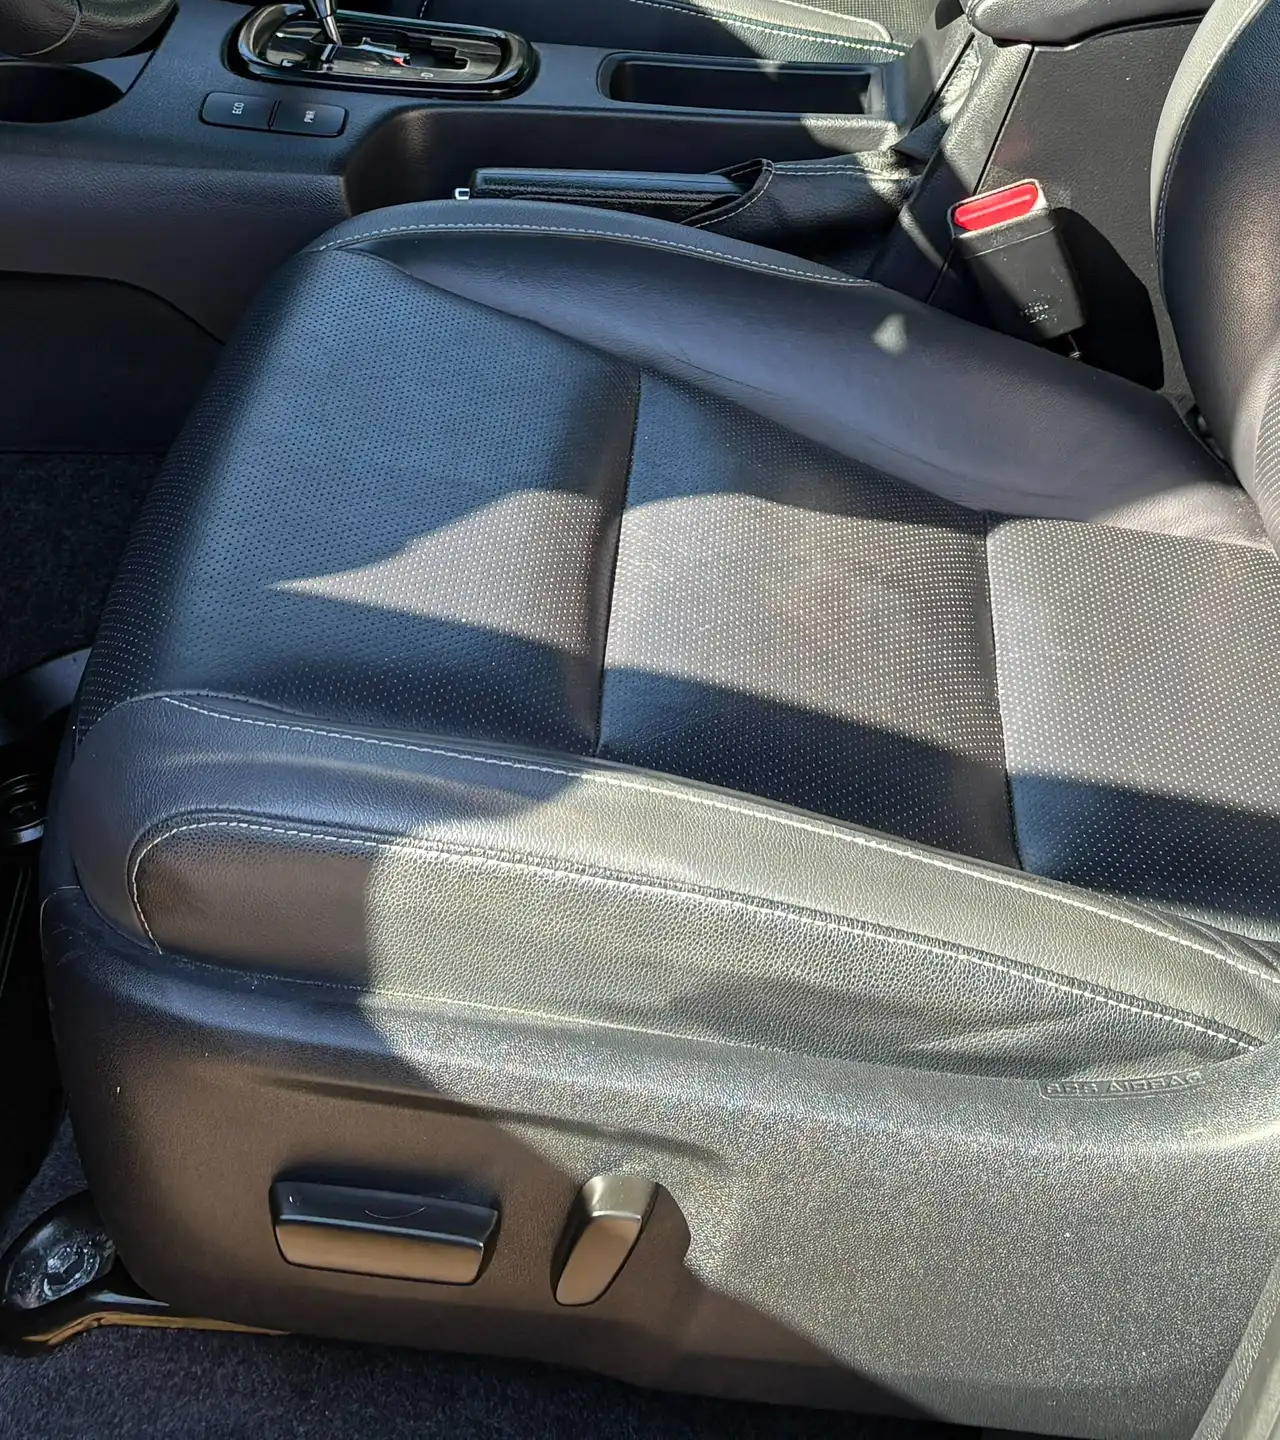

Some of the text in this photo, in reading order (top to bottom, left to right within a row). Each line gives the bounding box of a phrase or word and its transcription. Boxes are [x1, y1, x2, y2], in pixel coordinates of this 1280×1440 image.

[231, 101, 245, 115] ECO
[303, 109, 317, 124] PWR
[1046, 1070, 1203, 1095] SRS AIRBAG
